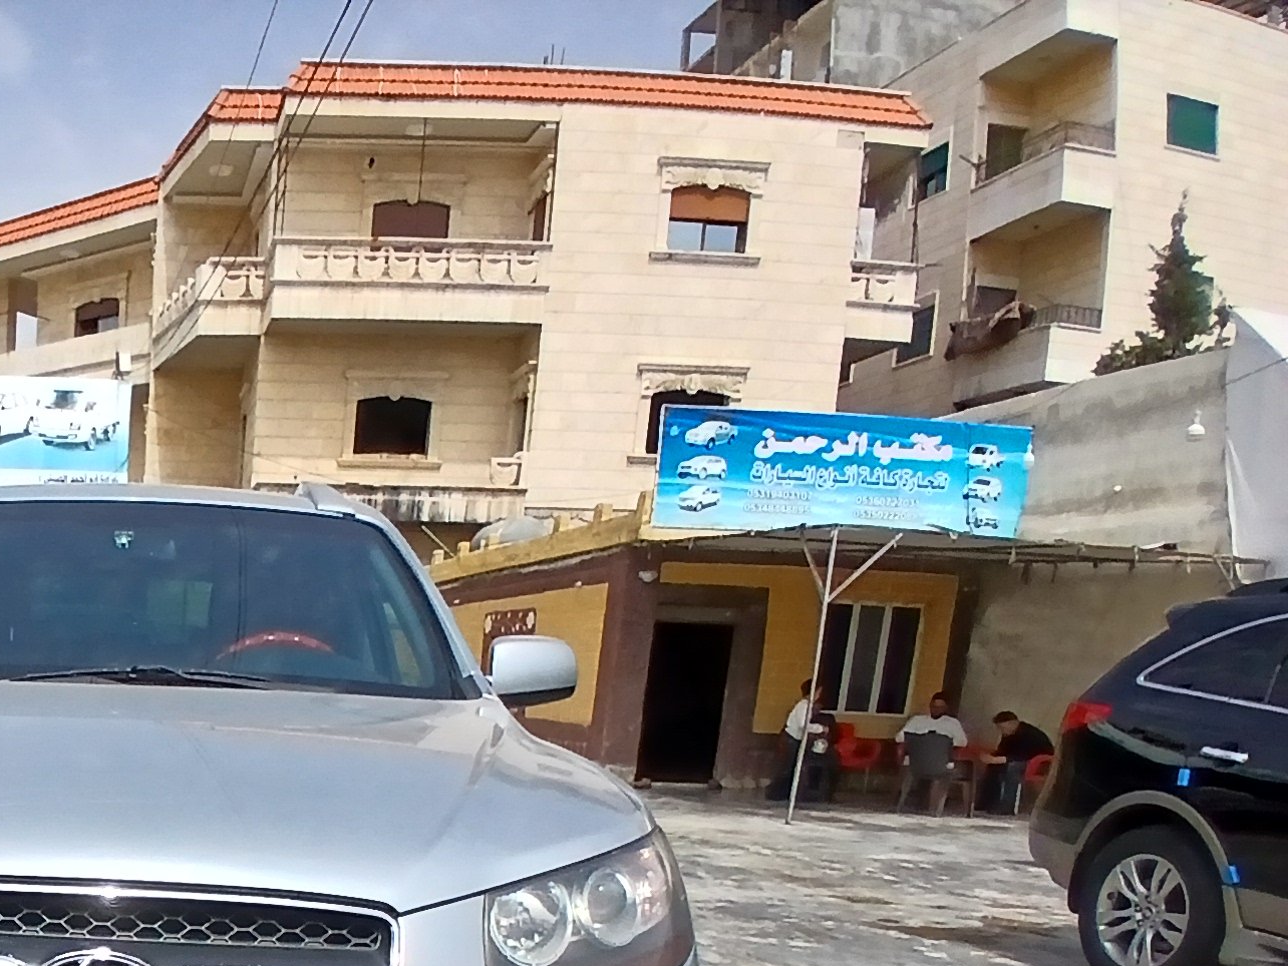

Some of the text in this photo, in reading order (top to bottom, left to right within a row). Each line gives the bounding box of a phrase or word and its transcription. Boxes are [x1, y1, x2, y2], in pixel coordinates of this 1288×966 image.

[753, 428, 953, 465] مكتب الرحمن
[750, 460, 950, 496] لتجارة كافة أنواع السيارات
